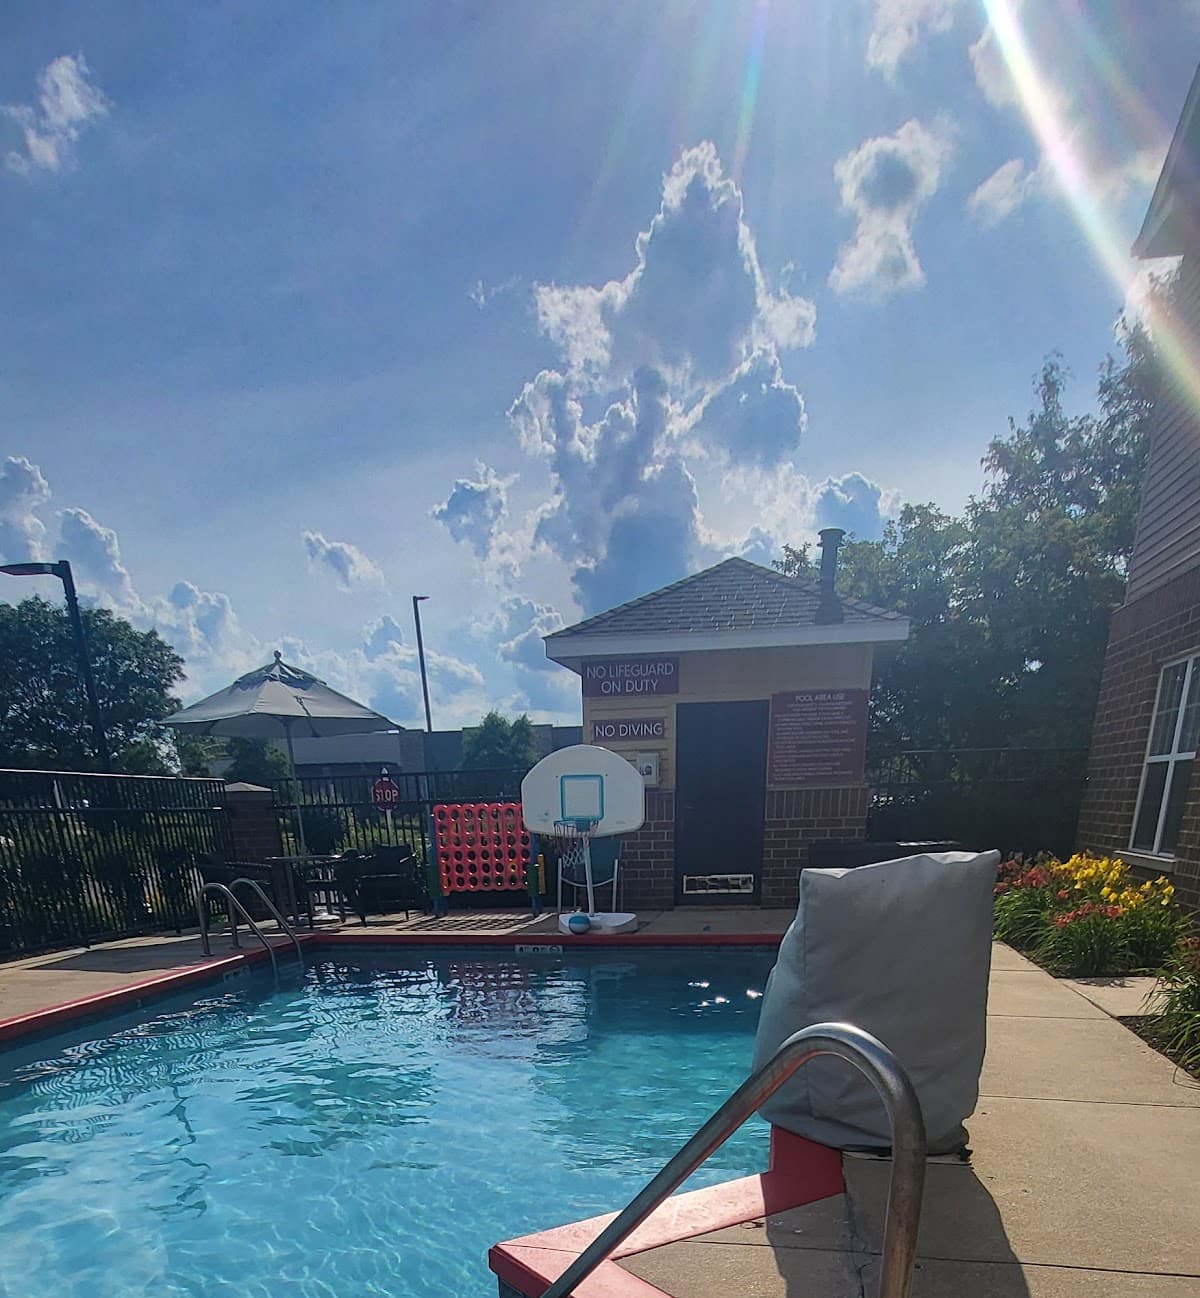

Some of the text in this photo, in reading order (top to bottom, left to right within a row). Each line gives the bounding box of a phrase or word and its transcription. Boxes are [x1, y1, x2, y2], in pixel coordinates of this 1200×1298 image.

[586, 662, 674, 679] NO LIFEGUARD
[601, 679, 659, 694] ON DUTY
[595, 722, 663, 737] NO DIVING
[375, 789, 399, 802] STOP
